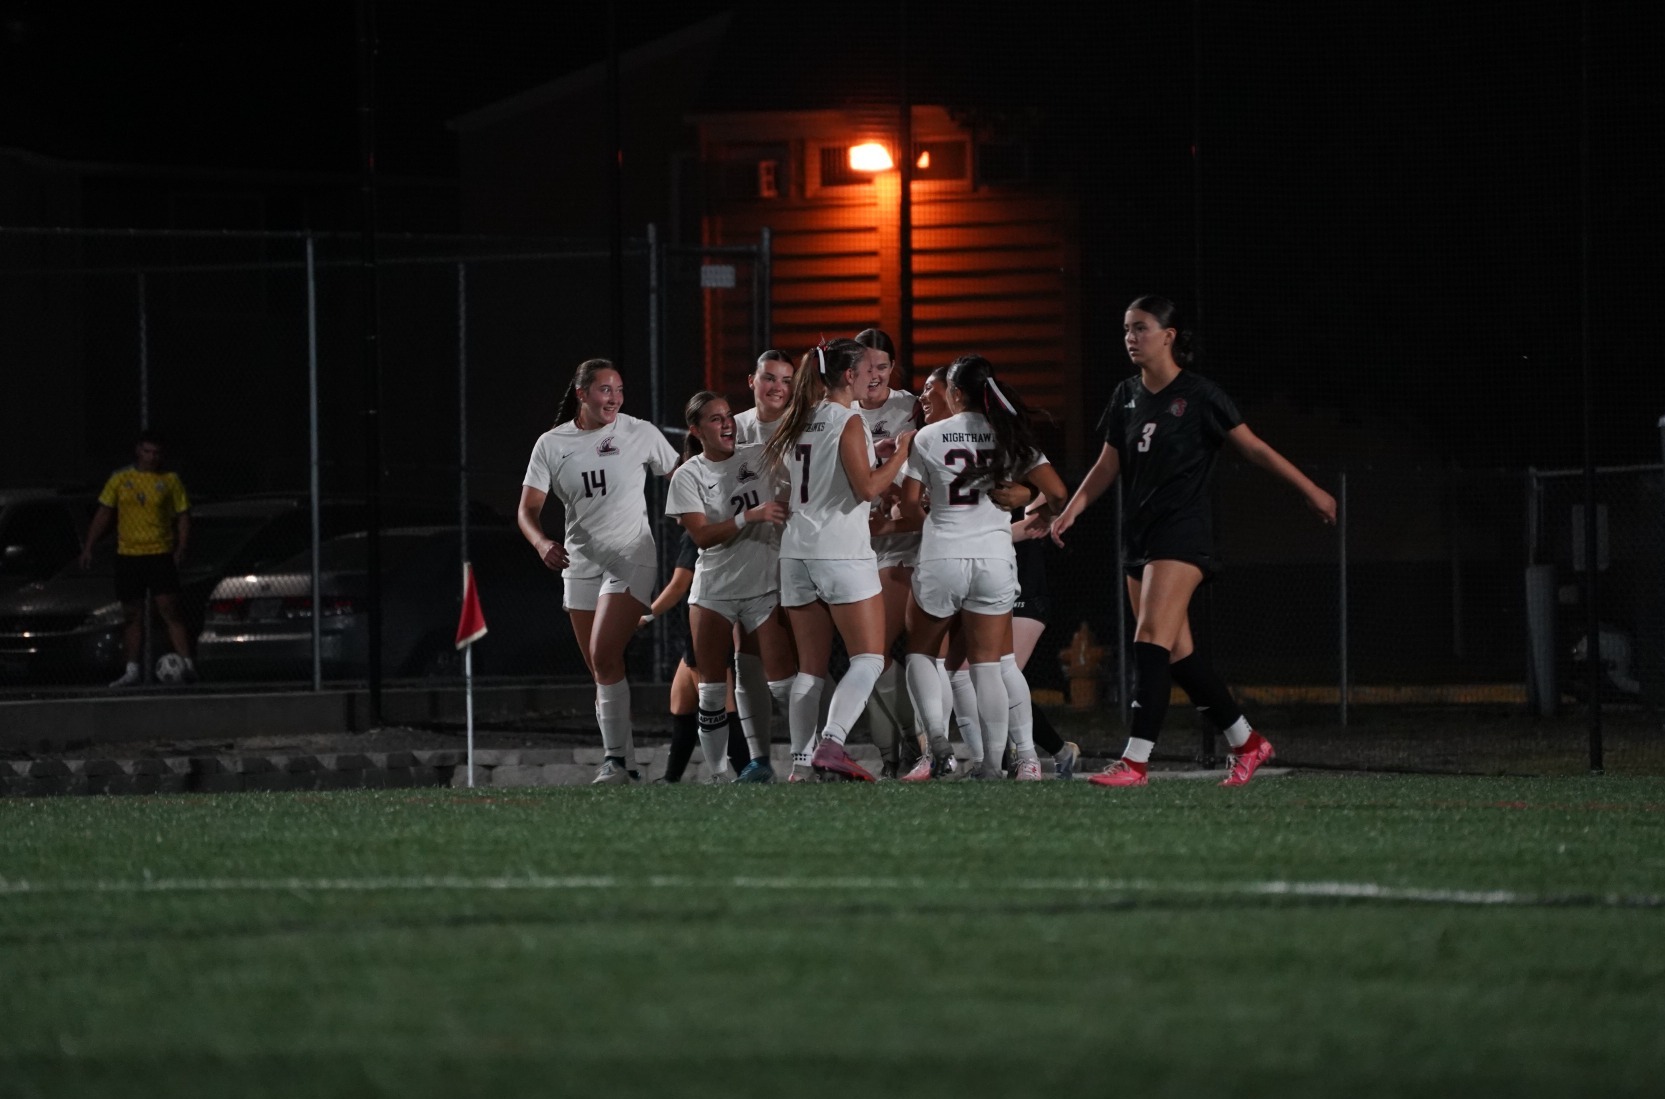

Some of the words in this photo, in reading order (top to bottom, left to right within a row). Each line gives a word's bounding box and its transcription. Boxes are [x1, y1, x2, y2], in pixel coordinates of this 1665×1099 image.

[1137, 422, 1157, 453] 3
[581, 469, 607, 498] 14
[795, 444, 811, 504] 7
